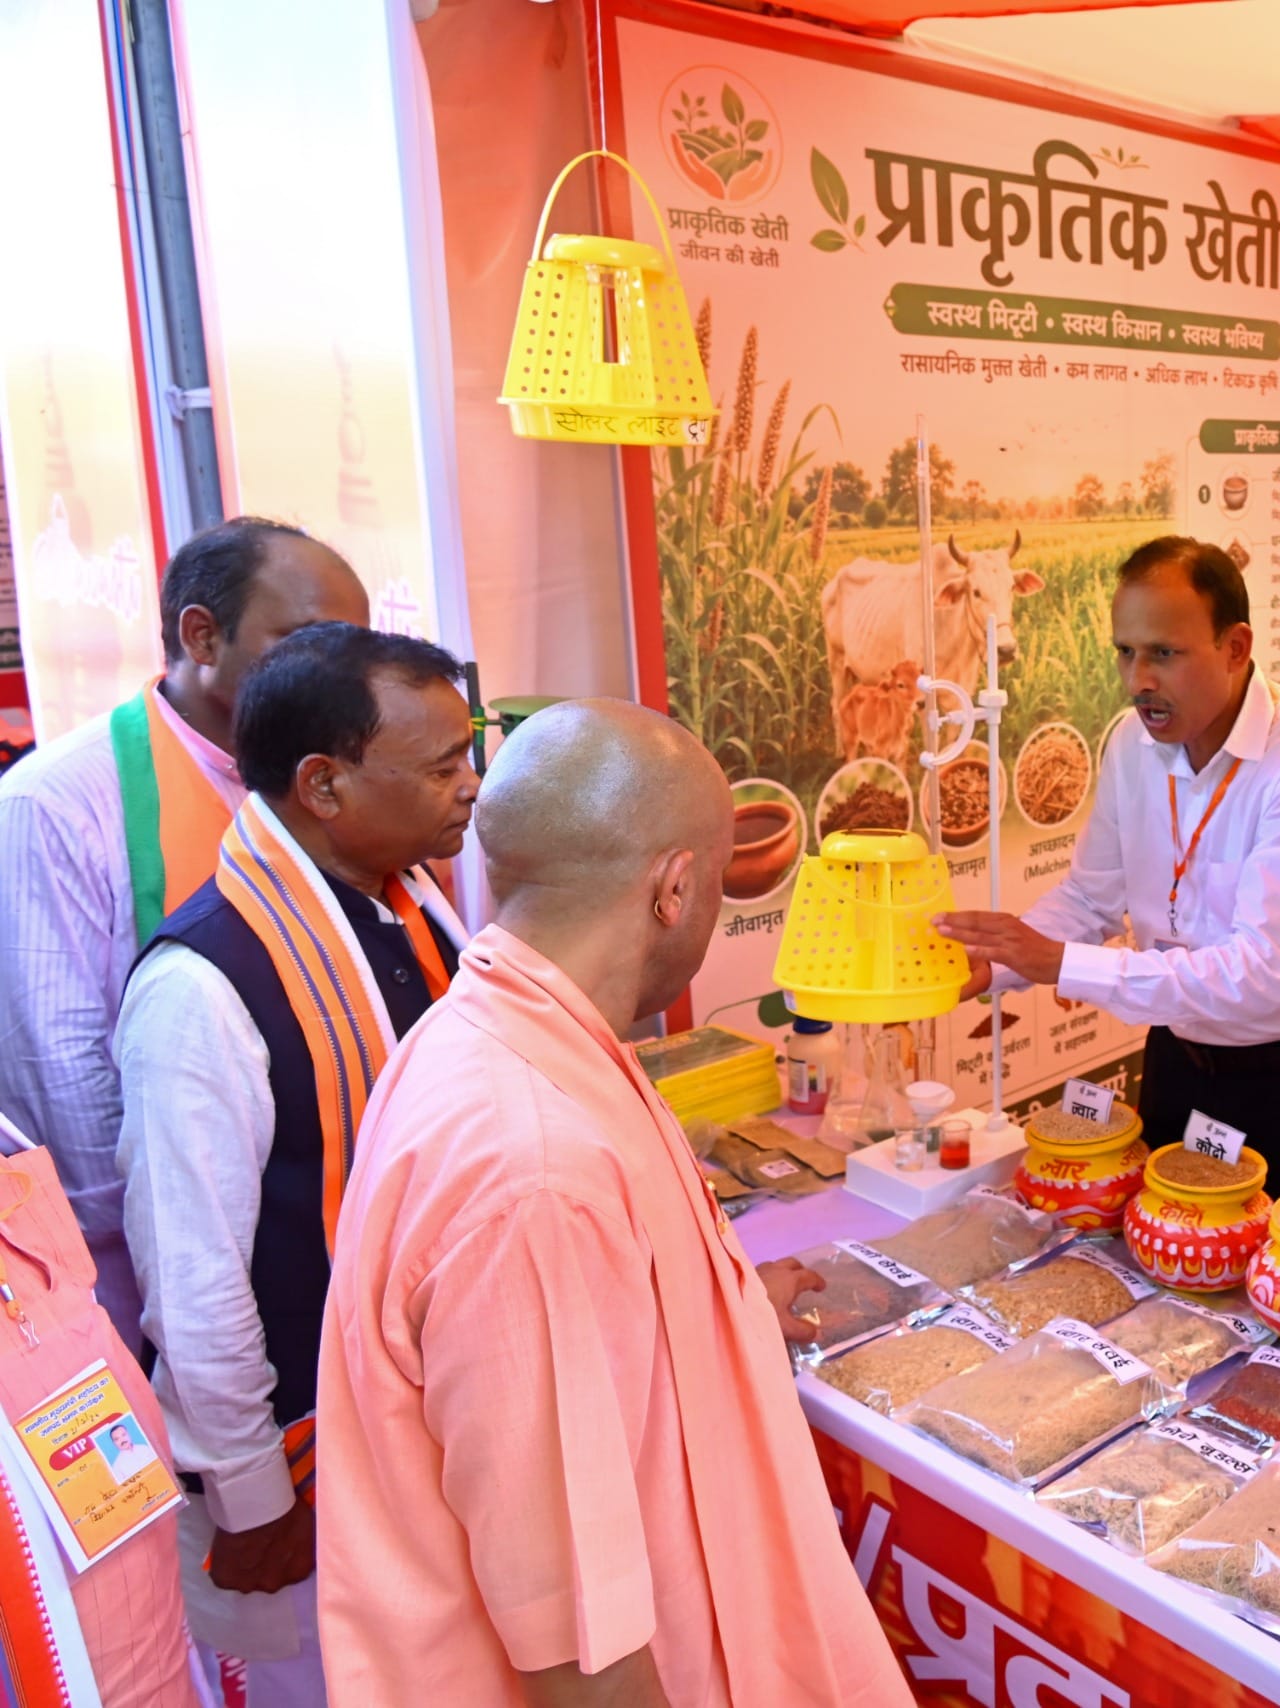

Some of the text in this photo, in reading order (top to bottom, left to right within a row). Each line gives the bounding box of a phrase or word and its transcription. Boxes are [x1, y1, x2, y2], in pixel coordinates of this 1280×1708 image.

[667, 206, 789, 241] प्राकृतिक खेती
[865, 139, 1168, 287] प्राकृतिक
[679, 240, 779, 267] जीवन की खेती
[926, 302, 982, 329] स्वस्थ
[1061, 312, 1107, 338] स्वस्थ
[1112, 309, 1162, 342] किसान
[1181, 323, 1222, 347] स्वस्थ
[1224, 322, 1265, 350] भविष्य
[900, 349, 976, 376] रासायनिक
[1018, 354, 1047, 379] खेती
[1066, 361, 1090, 380] कम
[1093, 363, 1128, 382] लागत
[1146, 362, 1181, 385] अधिक
[1234, 424, 1280, 452] प्राकृतिक
[947, 856, 987, 879] ीजामृत
[1024, 858, 1072, 882] (Mulchin
[724, 908, 784, 937] जीवामृत
[1071, 1101, 1099, 1121] ज्वार
[1195, 1137, 1227, 1160] कोदो
[1040, 1157, 1092, 1181] ज्वार
[1159, 1200, 1206, 1226] कोदो
[984, 1331, 1011, 1351] पोह
[62, 1437, 88, 1460] VIP
